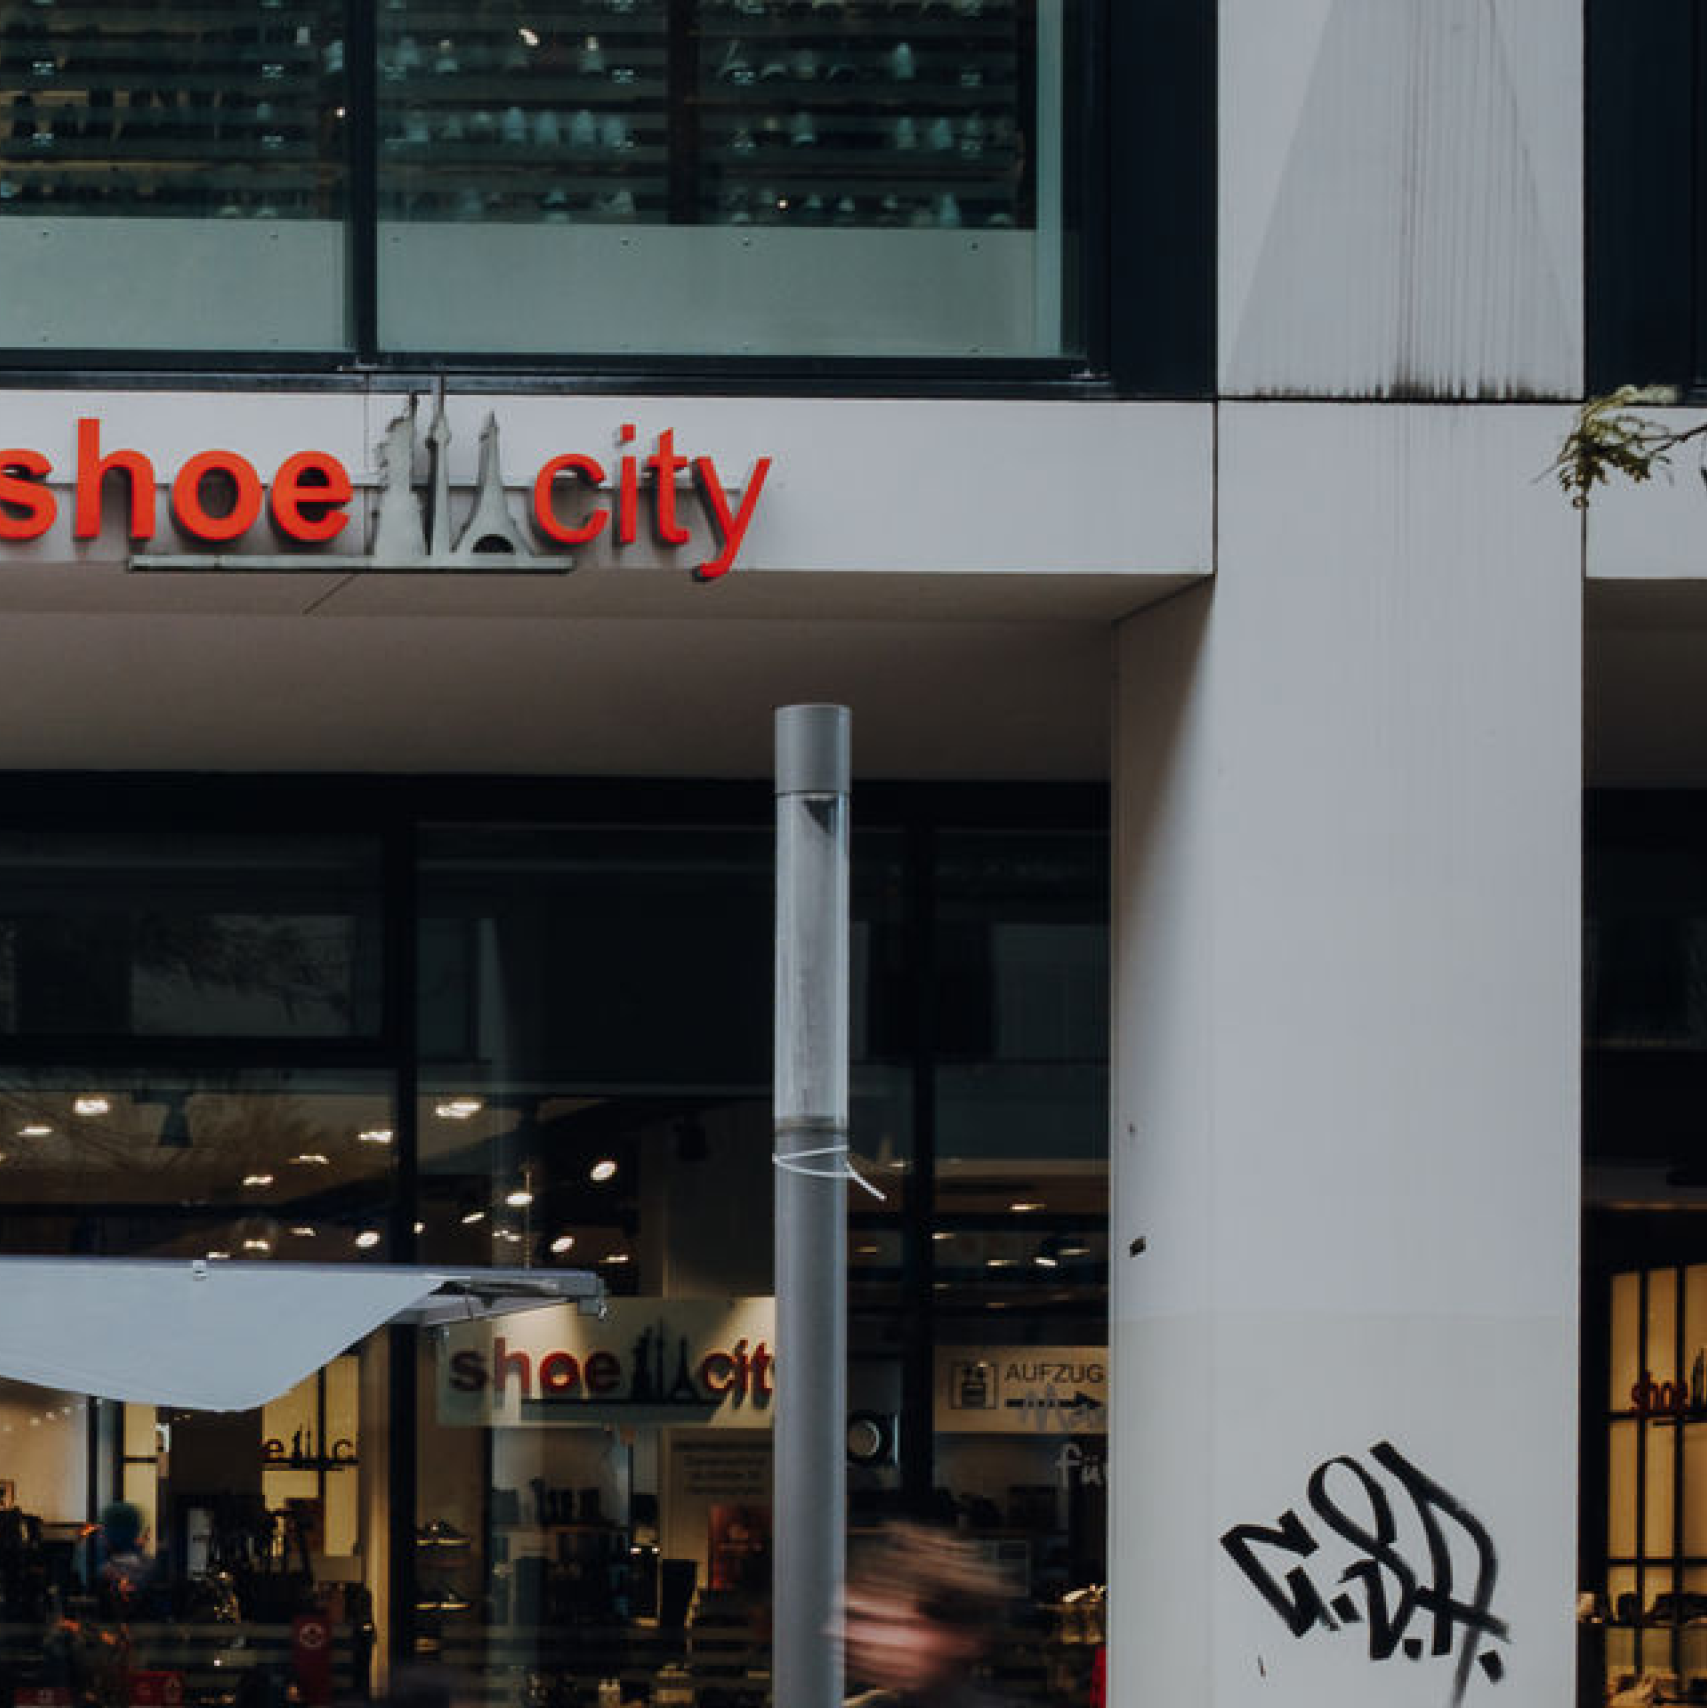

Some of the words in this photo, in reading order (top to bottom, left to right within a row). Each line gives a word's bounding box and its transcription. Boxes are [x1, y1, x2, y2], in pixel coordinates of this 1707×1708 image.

[533, 423, 773, 581] city
[448, 1337, 622, 1394] shoe
[701, 1337, 774, 1397] cit
[1004, 1363, 1105, 1383] AUFZUG
[1055, 1442, 1108, 1490] fü
